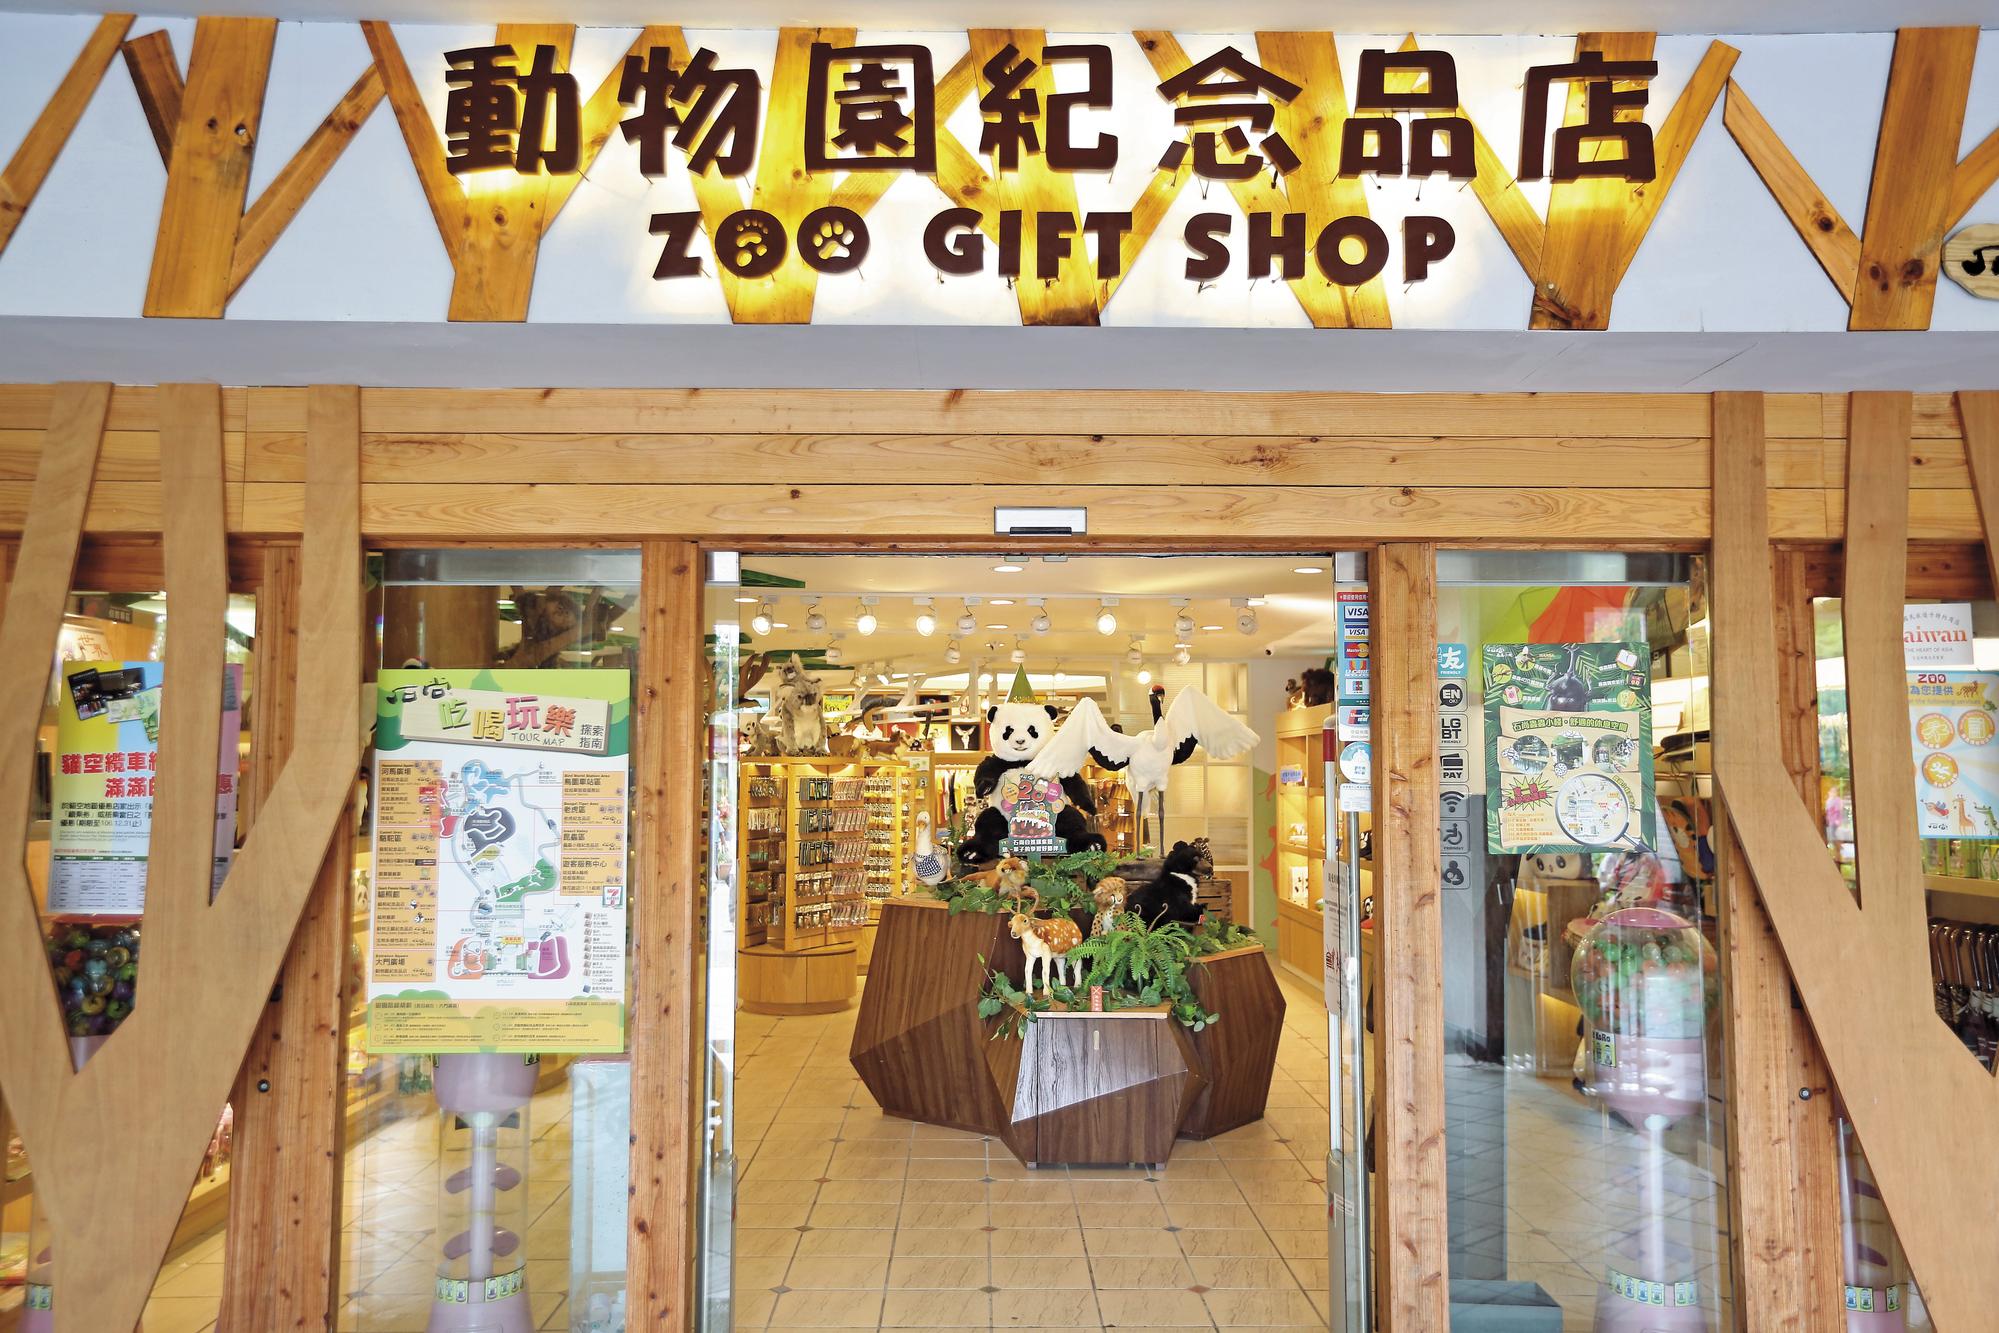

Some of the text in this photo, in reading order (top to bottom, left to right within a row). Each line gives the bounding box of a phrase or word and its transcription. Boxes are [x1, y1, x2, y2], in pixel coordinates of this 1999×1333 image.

[444, 43, 1658, 184] 動物園紀念品店
[648, 206, 1455, 287] ZOO GIFT SHOP
[1347, 608, 1368, 616] VISA
[1440, 647, 1464, 669] 友
[1918, 674, 1946, 684] ZOO
[1442, 689, 1460, 699] EN
[438, 696, 576, 742] 吃喝玩樂
[1441, 718, 1461, 728] LG
[512, 732, 565, 747] TOUR MAP
[1441, 729, 1461, 739] BT
